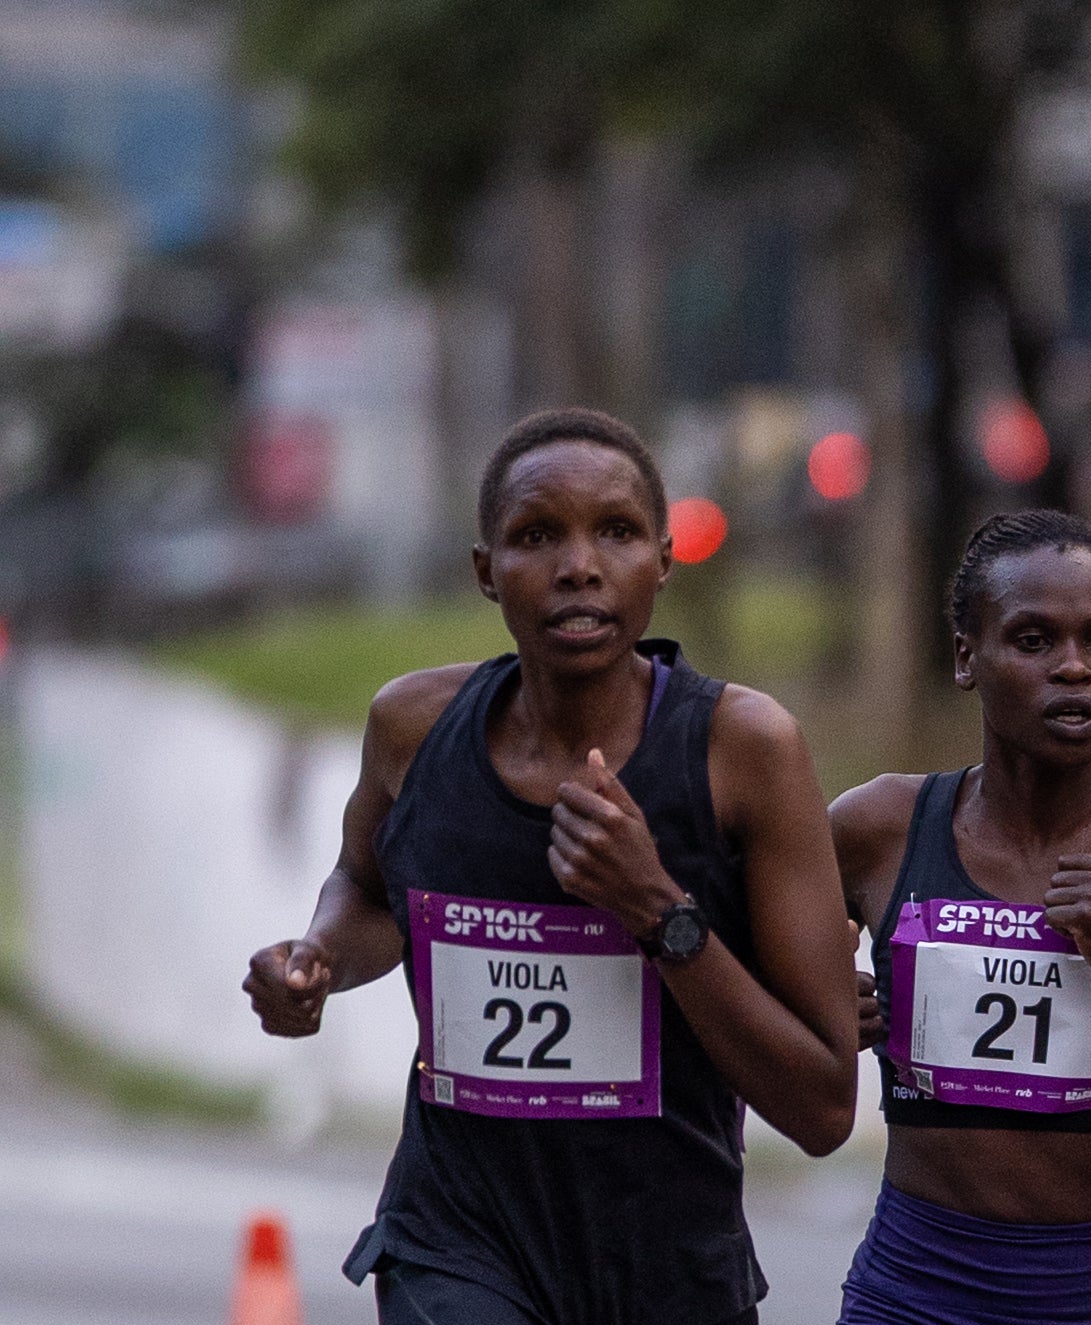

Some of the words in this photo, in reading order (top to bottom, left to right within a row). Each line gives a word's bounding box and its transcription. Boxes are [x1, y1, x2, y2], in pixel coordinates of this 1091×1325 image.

[445, 903, 544, 942] SP10K
[936, 904, 1045, 941] SP10K
[487, 960, 568, 992] VIOLA
[983, 957, 1063, 989] VIOLA
[482, 998, 572, 1070] 22
[971, 992, 1053, 1065] 21
[892, 1086, 919, 1100] new
